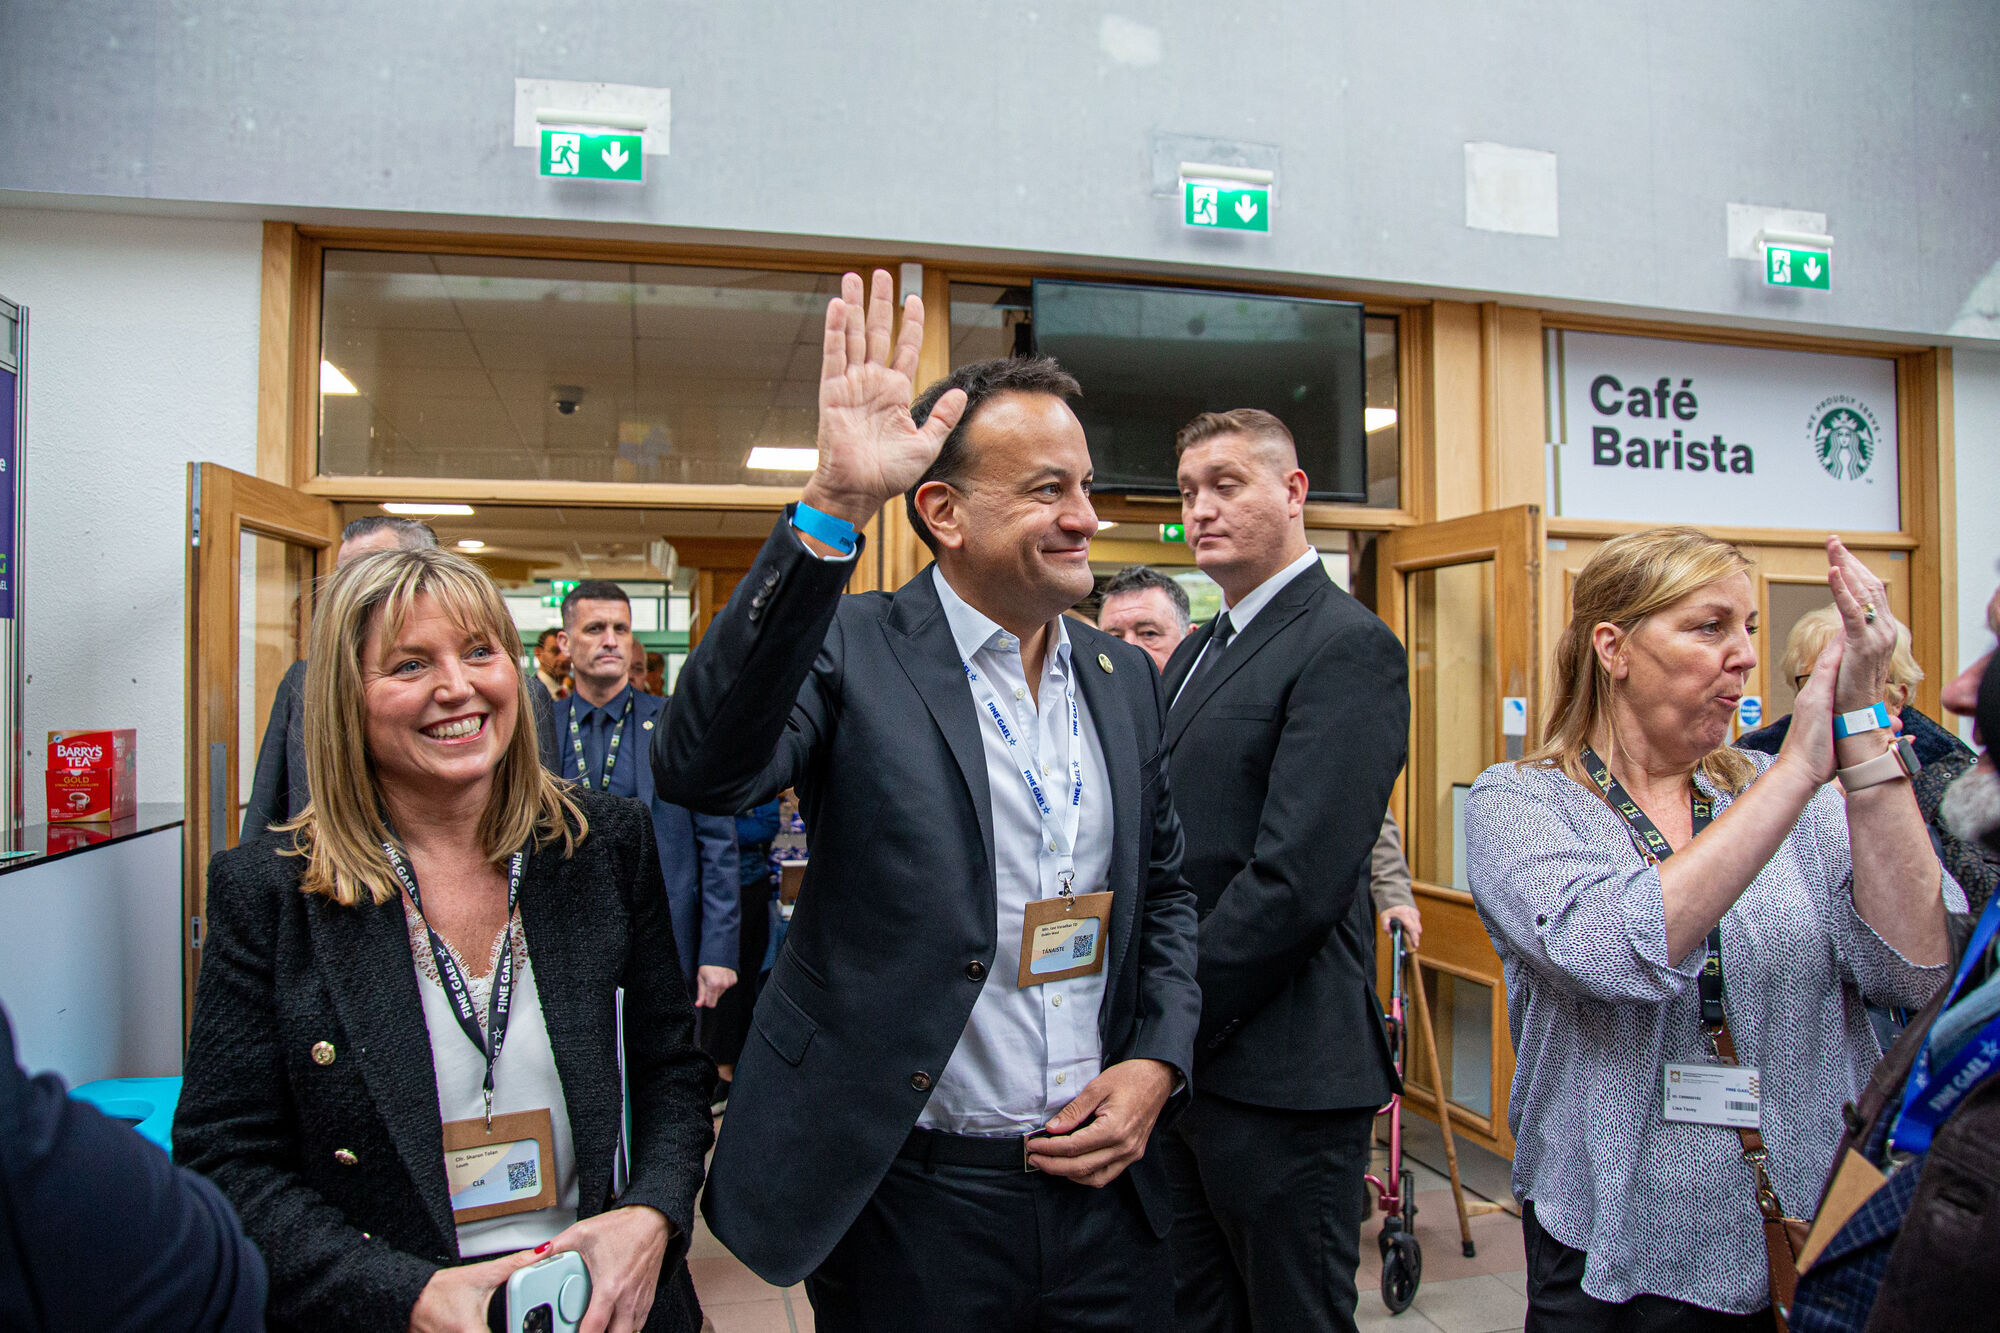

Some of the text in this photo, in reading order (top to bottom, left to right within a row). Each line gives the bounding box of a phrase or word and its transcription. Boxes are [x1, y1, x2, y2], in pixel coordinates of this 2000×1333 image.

[1590, 374, 1698, 421] Café
[1592, 426, 1754, 474] Barista
[987, 701, 1011, 740] FINE GAEL
[64, 776, 90, 784] GOLD
[66, 757, 91, 767] TEA
[1023, 769, 1045, 807] FINE GAEL
[1072, 788, 1081, 806] FINE
[382, 841, 416, 895] FINE GAEL
[512, 851, 523, 877] FINE
[444, 958, 473, 1020] FINE GAEL
[497, 952, 512, 1013] FINE GAEL
[1928, 1084, 1961, 1112] FINE
[1952, 1057, 1991, 1090] GAEL
[472, 1179, 485, 1187] CLR
